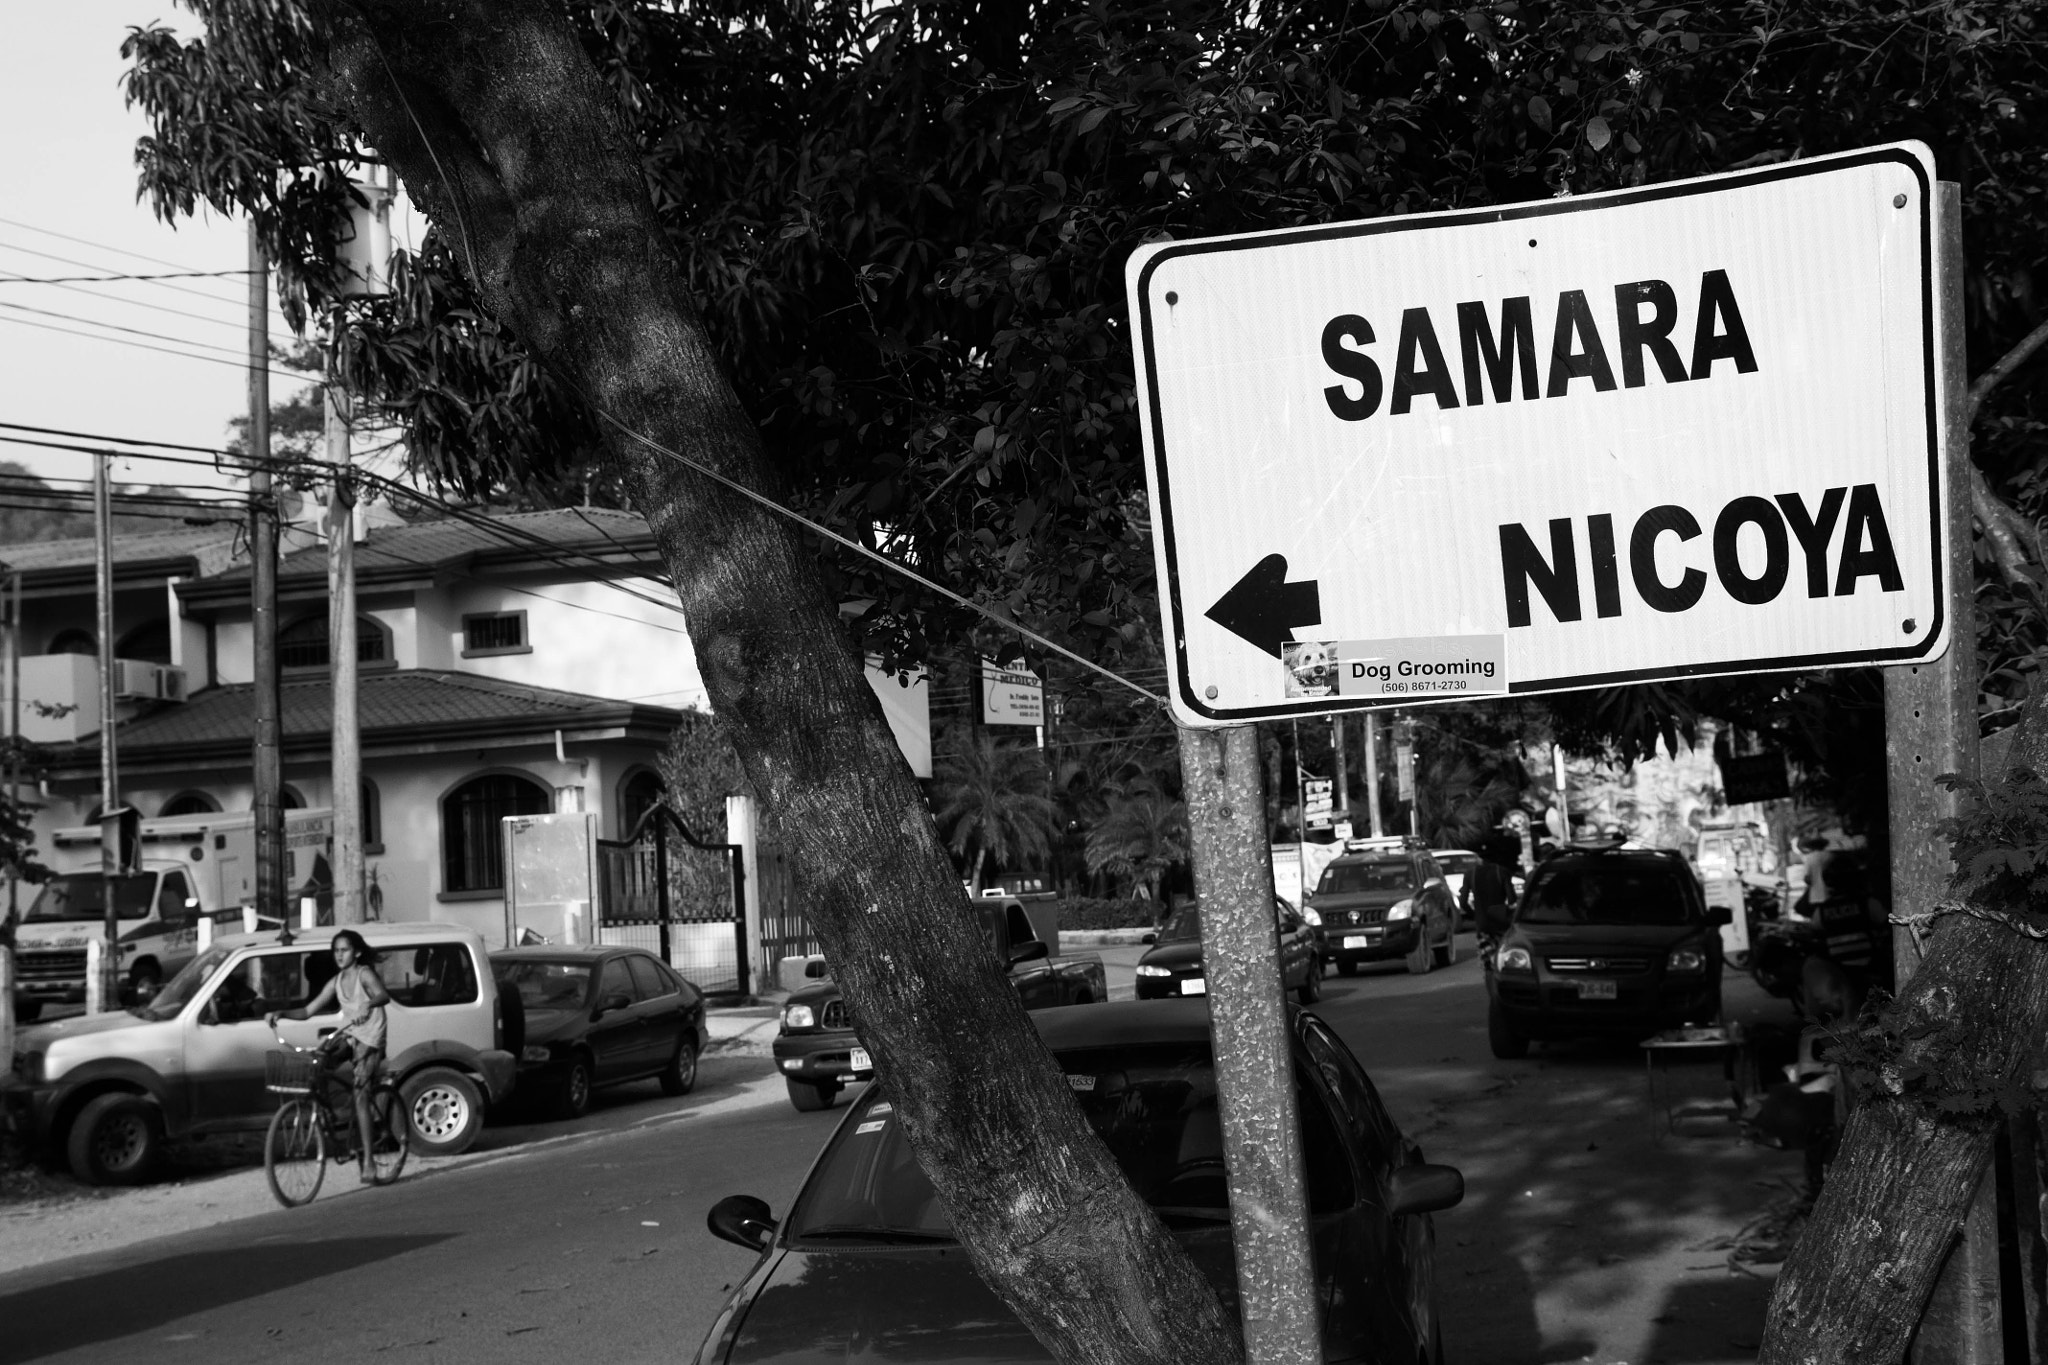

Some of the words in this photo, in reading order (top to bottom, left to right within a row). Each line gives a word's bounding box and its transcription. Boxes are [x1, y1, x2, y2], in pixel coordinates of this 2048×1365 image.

[1322, 269, 1758, 421] SAMARA
[1499, 484, 1904, 628] NICOYA
[1352, 662, 1391, 681] Dog
[1397, 658, 1495, 678] Grooming
[1381, 682, 1409, 693] (506)
[1411, 680, 1467, 691] 8671-2730
